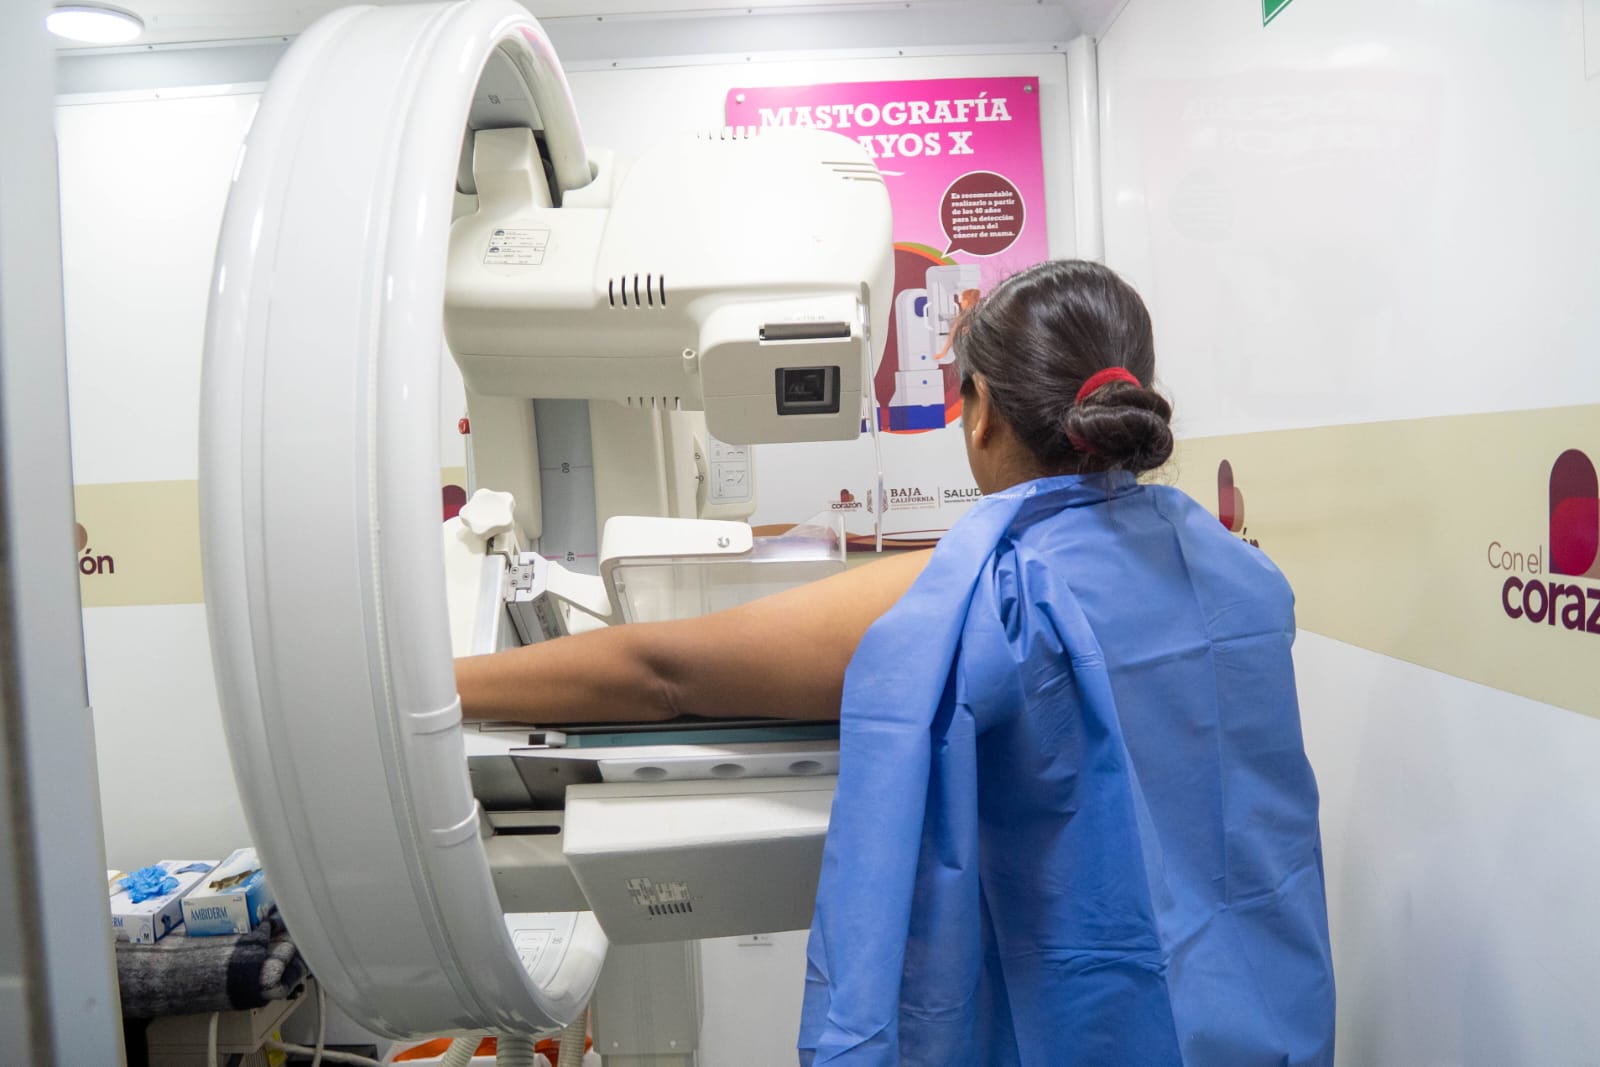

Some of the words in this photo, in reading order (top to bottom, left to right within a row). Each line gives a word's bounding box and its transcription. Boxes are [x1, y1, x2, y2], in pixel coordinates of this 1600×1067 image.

[758, 91, 1012, 130] MASTOGRAFÍA
[948, 131, 974, 155] X
[961, 191, 1013, 199] recomendable
[994, 199, 1015, 207] partir
[890, 487, 922, 498] BAJA
[943, 488, 982, 498] SALUD
[890, 496, 935, 504] CALIFORNIA
[831, 502, 862, 510] corazón
[1487, 540, 1524, 572] Con
[1527, 545, 1543, 575] el
[191, 906, 228, 921] AMBIDERM
